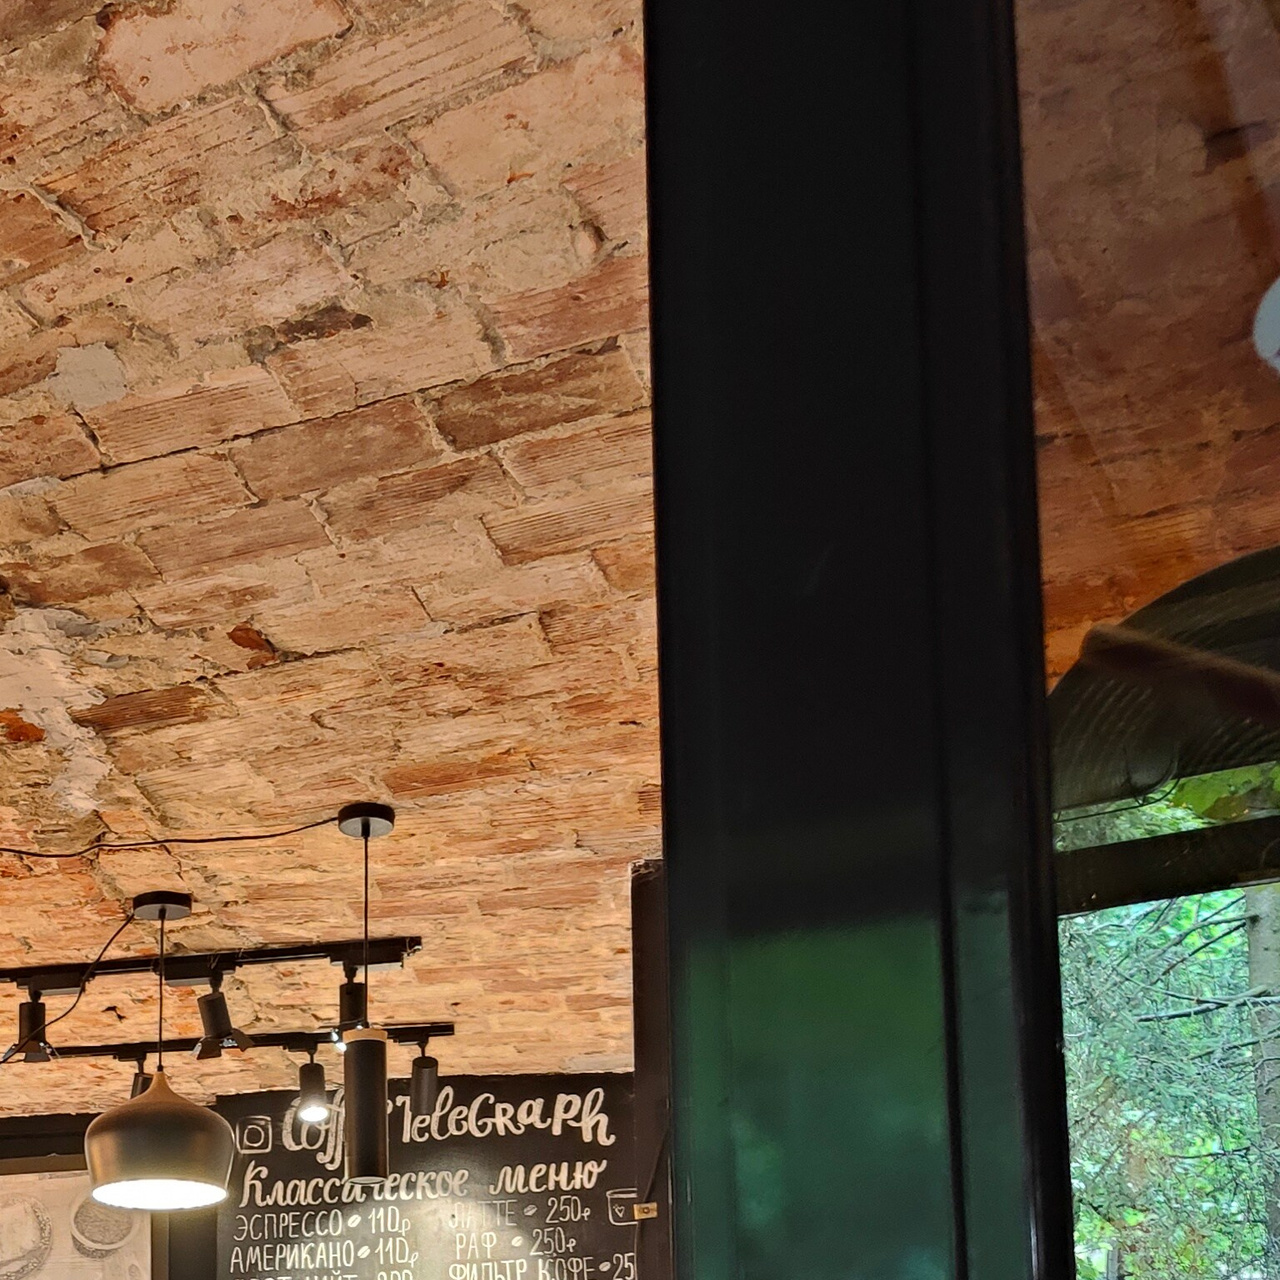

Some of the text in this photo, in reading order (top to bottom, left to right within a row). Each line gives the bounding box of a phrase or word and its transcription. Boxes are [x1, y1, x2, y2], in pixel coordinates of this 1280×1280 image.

[233, 1209, 343, 1241] ЭСПРЕССО
[449, 1199, 519, 1229] ЛАТТЕ
[230, 1240, 355, 1274] АМЕРИКАНО
[456, 1231, 497, 1260] РАФ
